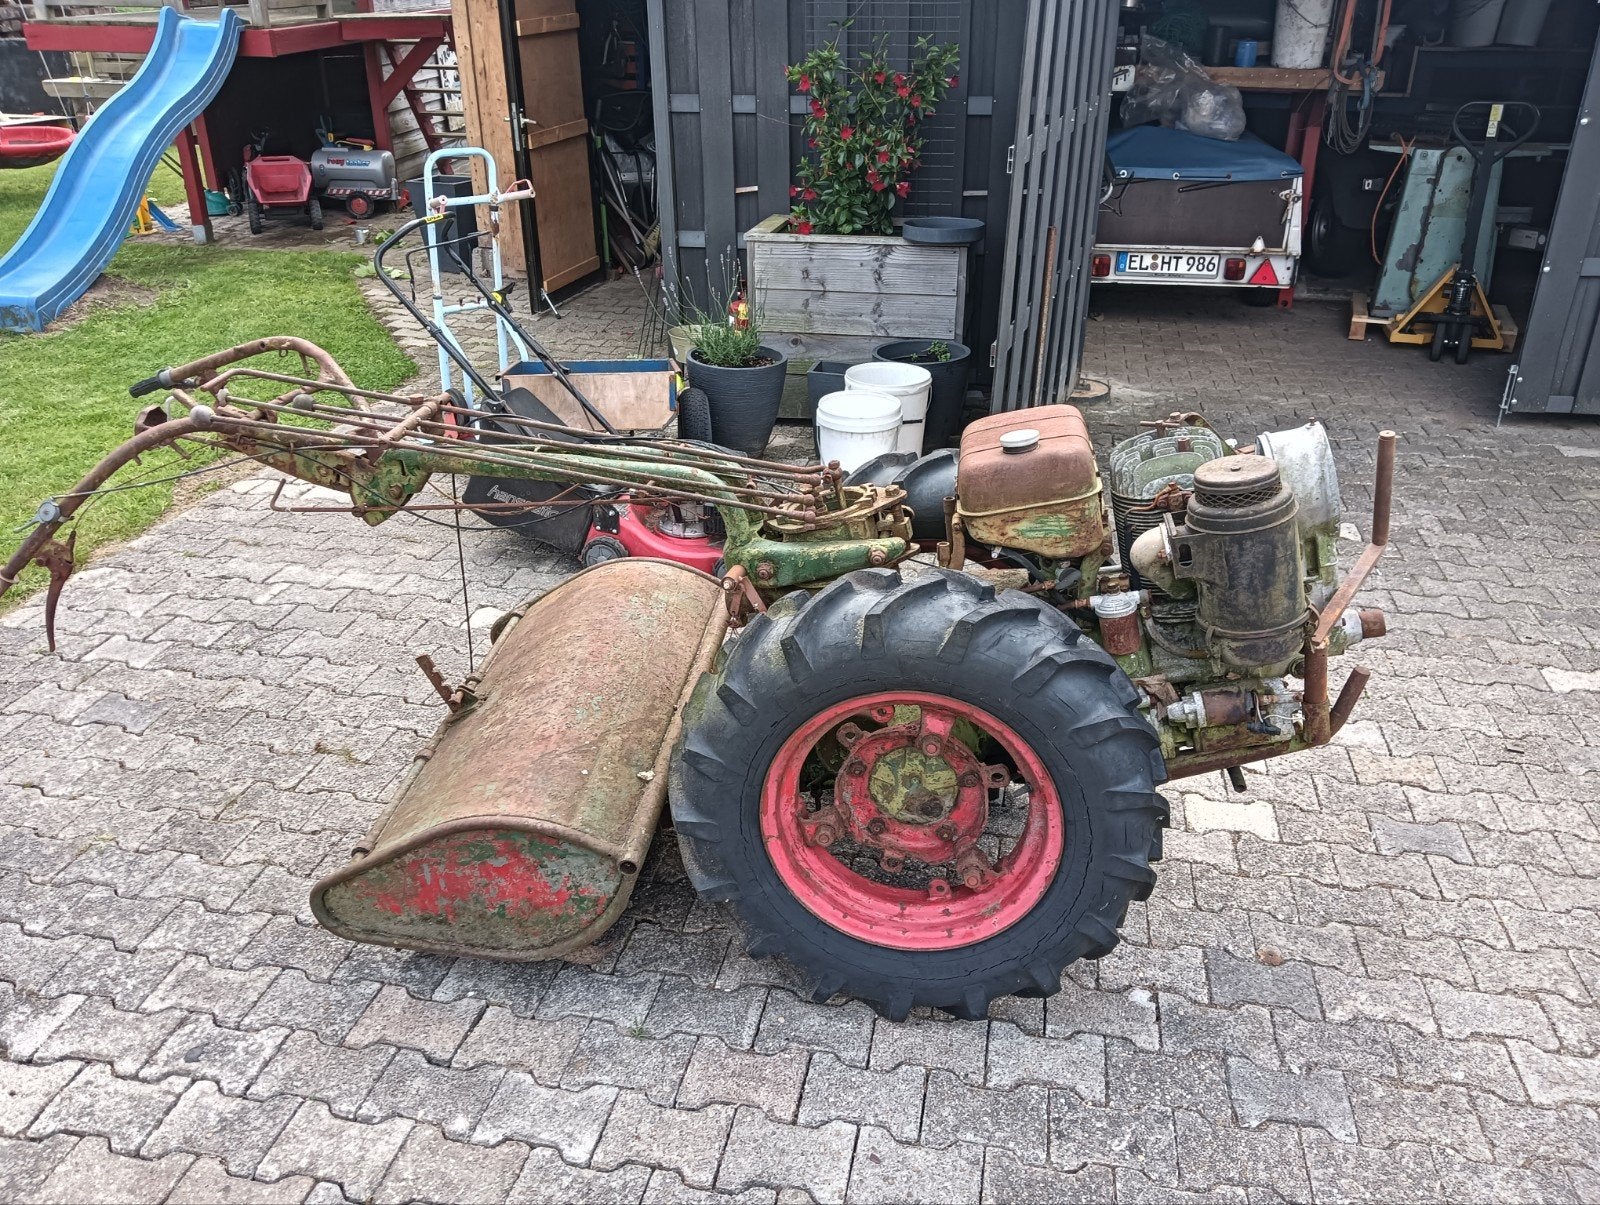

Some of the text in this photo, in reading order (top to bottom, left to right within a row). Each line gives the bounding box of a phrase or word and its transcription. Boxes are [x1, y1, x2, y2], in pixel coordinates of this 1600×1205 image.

[1128, 255, 1216, 272] EL HT 986
